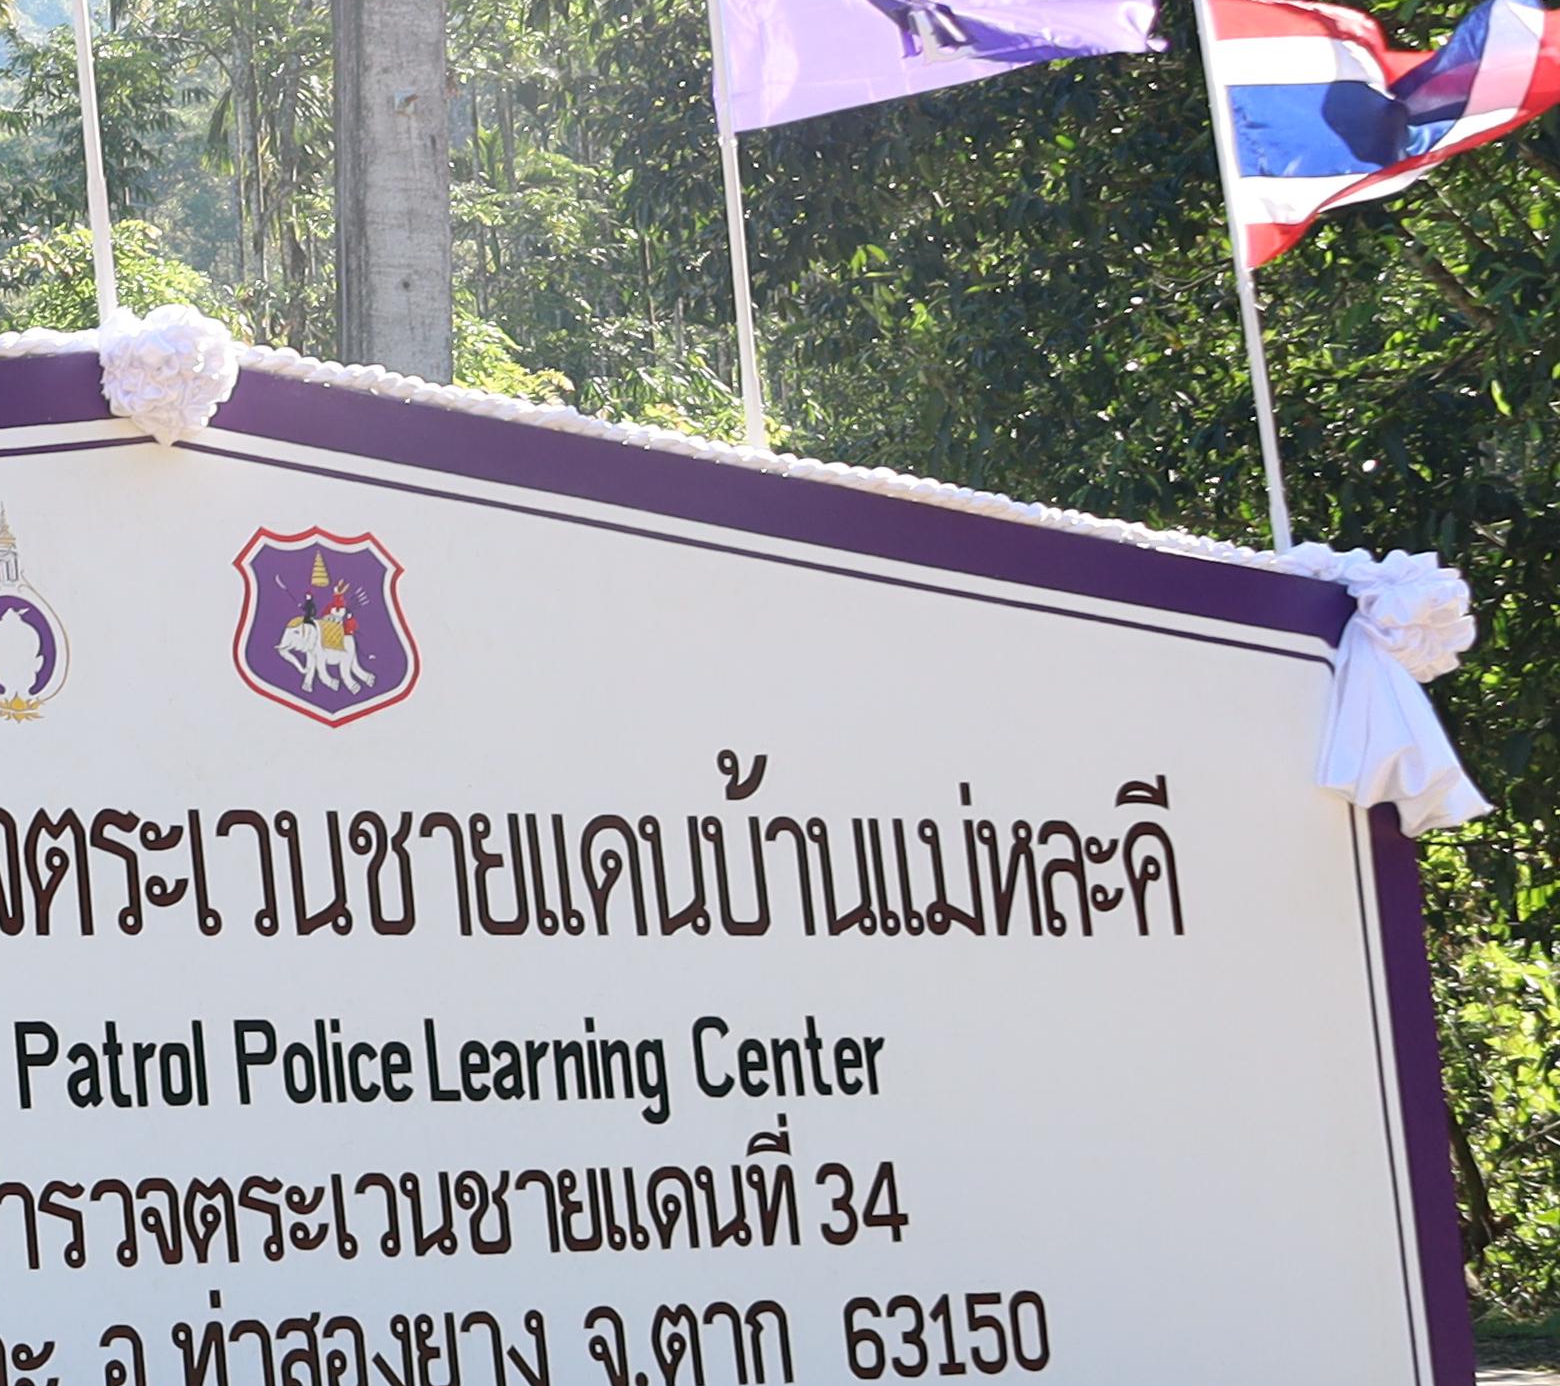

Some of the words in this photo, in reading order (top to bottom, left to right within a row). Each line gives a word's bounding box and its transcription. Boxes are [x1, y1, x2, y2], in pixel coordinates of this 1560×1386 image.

[13, 1018, 210, 1111] Patrol
[232, 1017, 415, 1106] Police
[423, 1015, 672, 1126] Learning
[691, 1014, 886, 1099] Center
[814, 1160, 910, 1247] 34
[842, 1289, 1052, 1381] 63150
